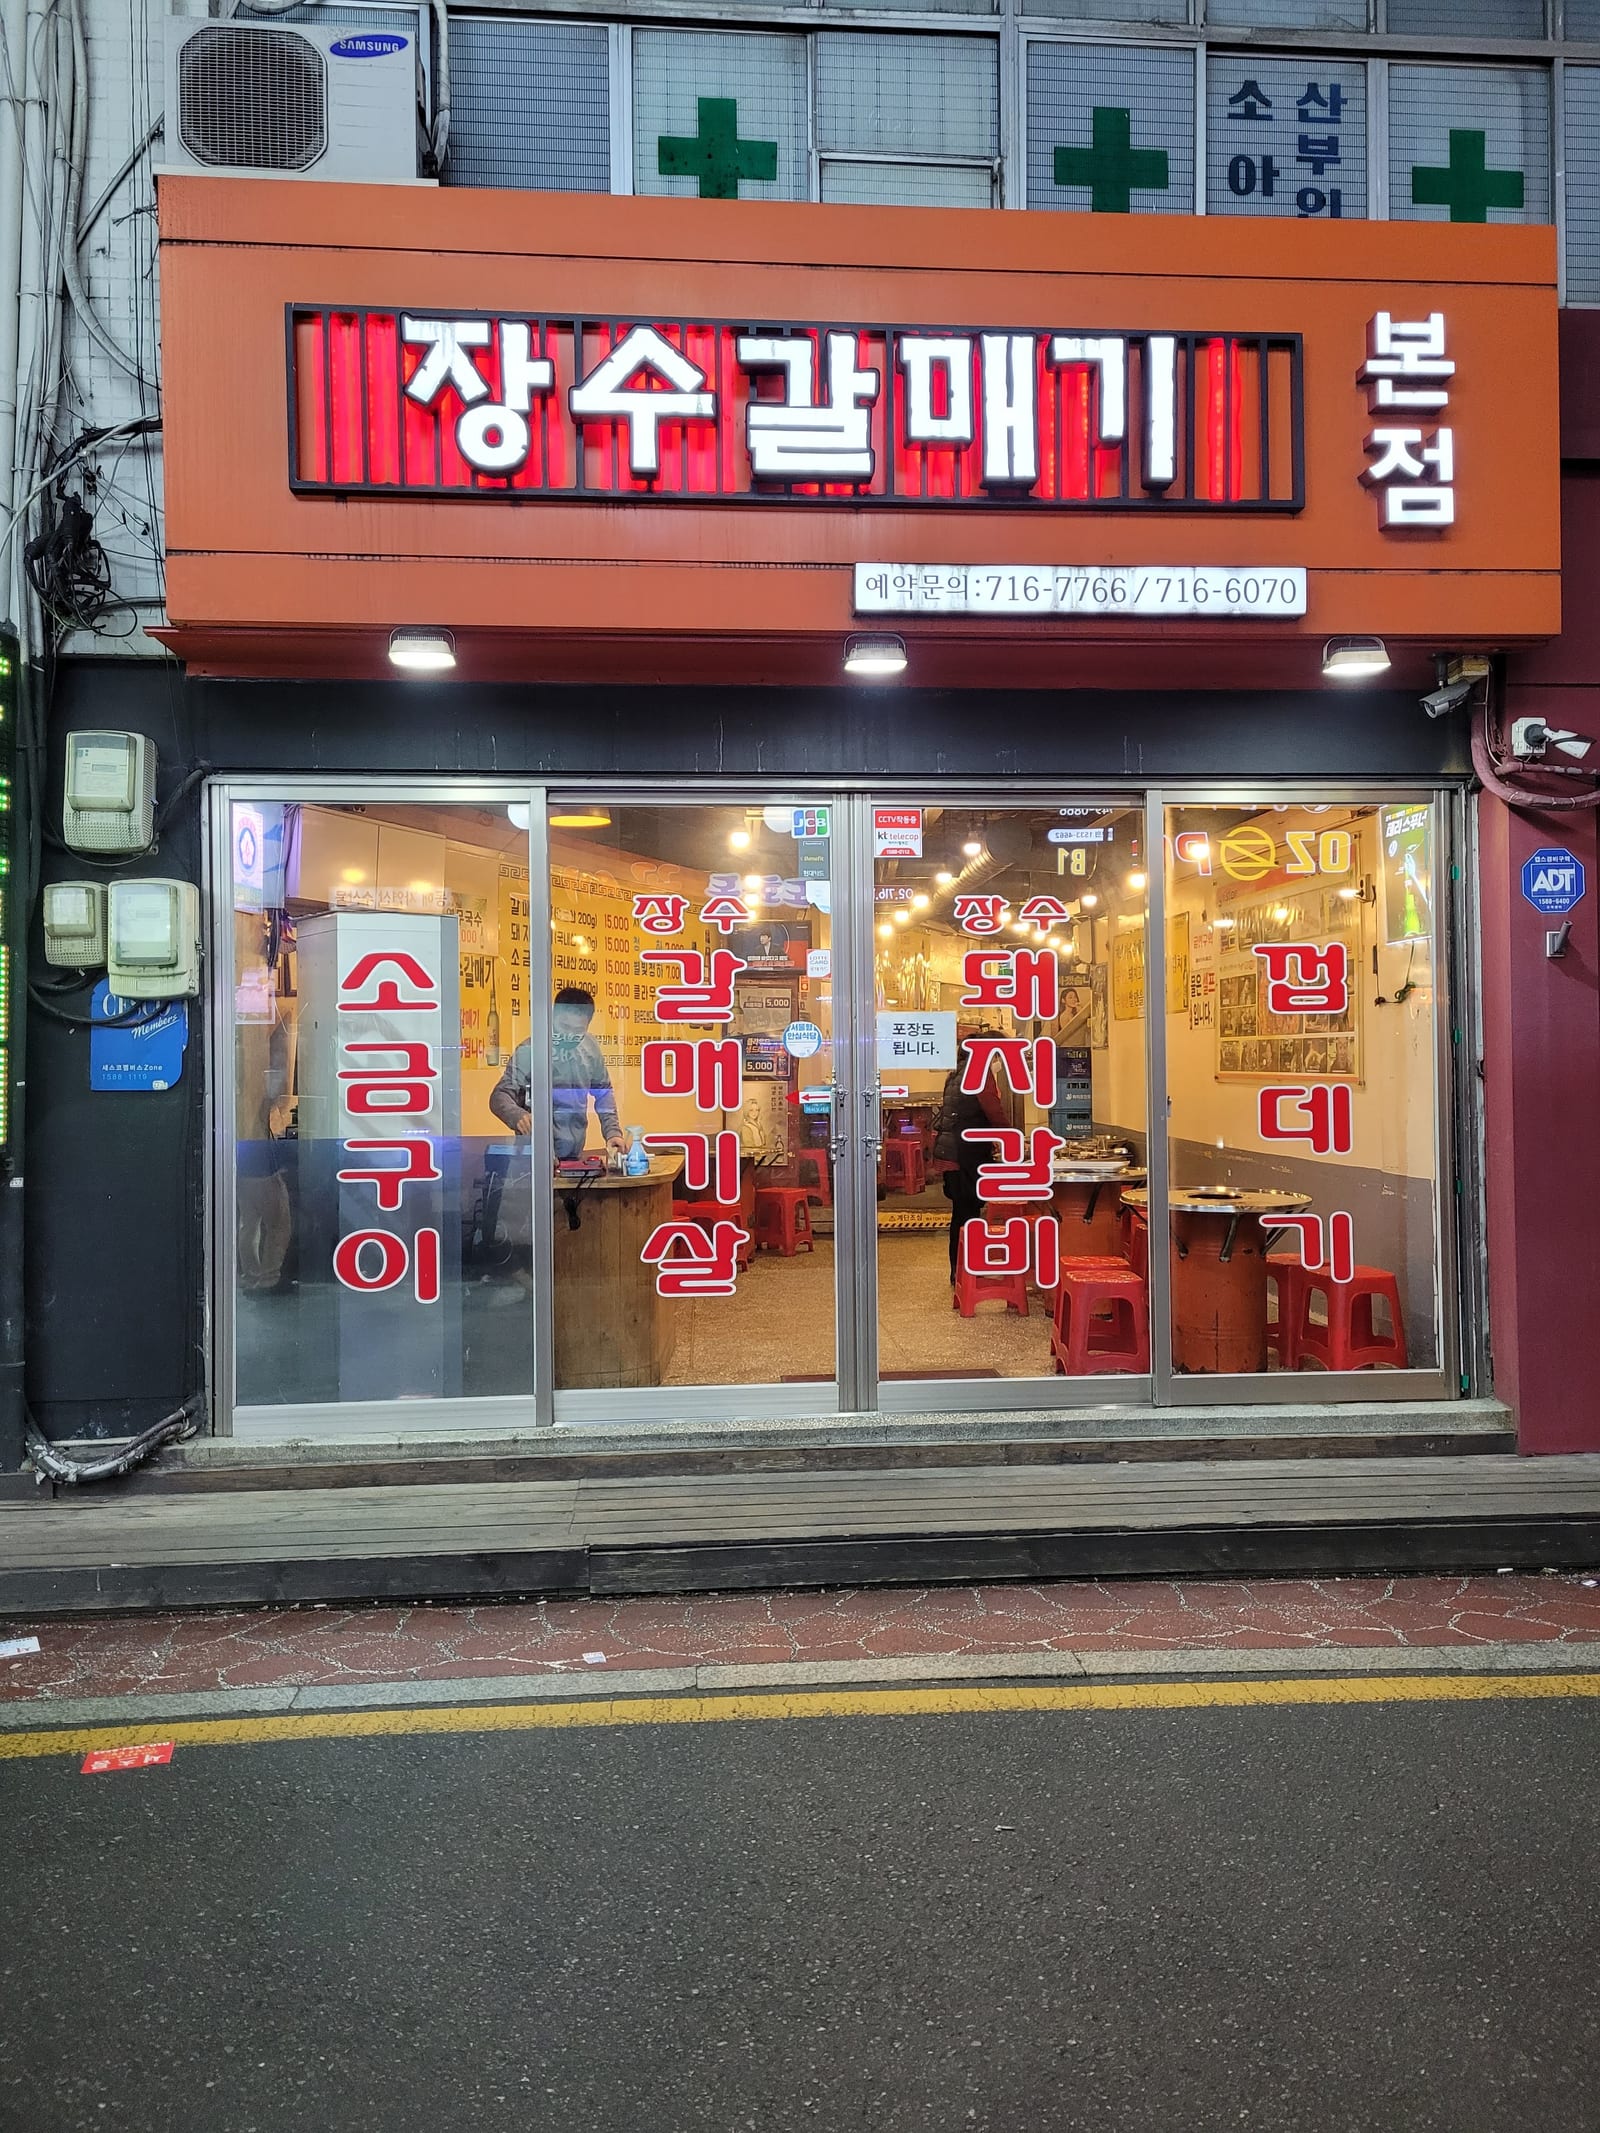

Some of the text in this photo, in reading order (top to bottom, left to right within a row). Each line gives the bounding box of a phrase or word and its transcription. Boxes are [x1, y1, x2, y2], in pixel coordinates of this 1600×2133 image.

[340, 40, 399, 52] SAMSUNG
[402, 313, 1176, 482] 장수갈매기
[1361, 311, 1455, 526] 본점
[877, 831, 888, 840] kt
[1532, 868, 1576, 892] ADT
[604, 914, 630, 932] 15,000
[632, 895, 752, 936] 장수
[953, 895, 1070, 936] 장수
[605, 936, 630, 953] 15,000
[605, 959, 630, 976] 15,000
[605, 981, 630, 998] 15,000
[634, 984, 657, 1001] 클라우
[766, 998, 789, 1008] 5,000
[131, 1013, 179, 1040] Members
[892, 1022, 936, 1037] 포장도
[892, 1041, 940, 1056] 됩니다.
[747, 1061, 773, 1071] 5,000
[959, 947, 1067, 1290] 돼지갈비
[1251, 942, 1355, 1285] 껍데기
[332, 951, 443, 1304] 소금구이
[639, 948, 750, 1298] 갈매기살
